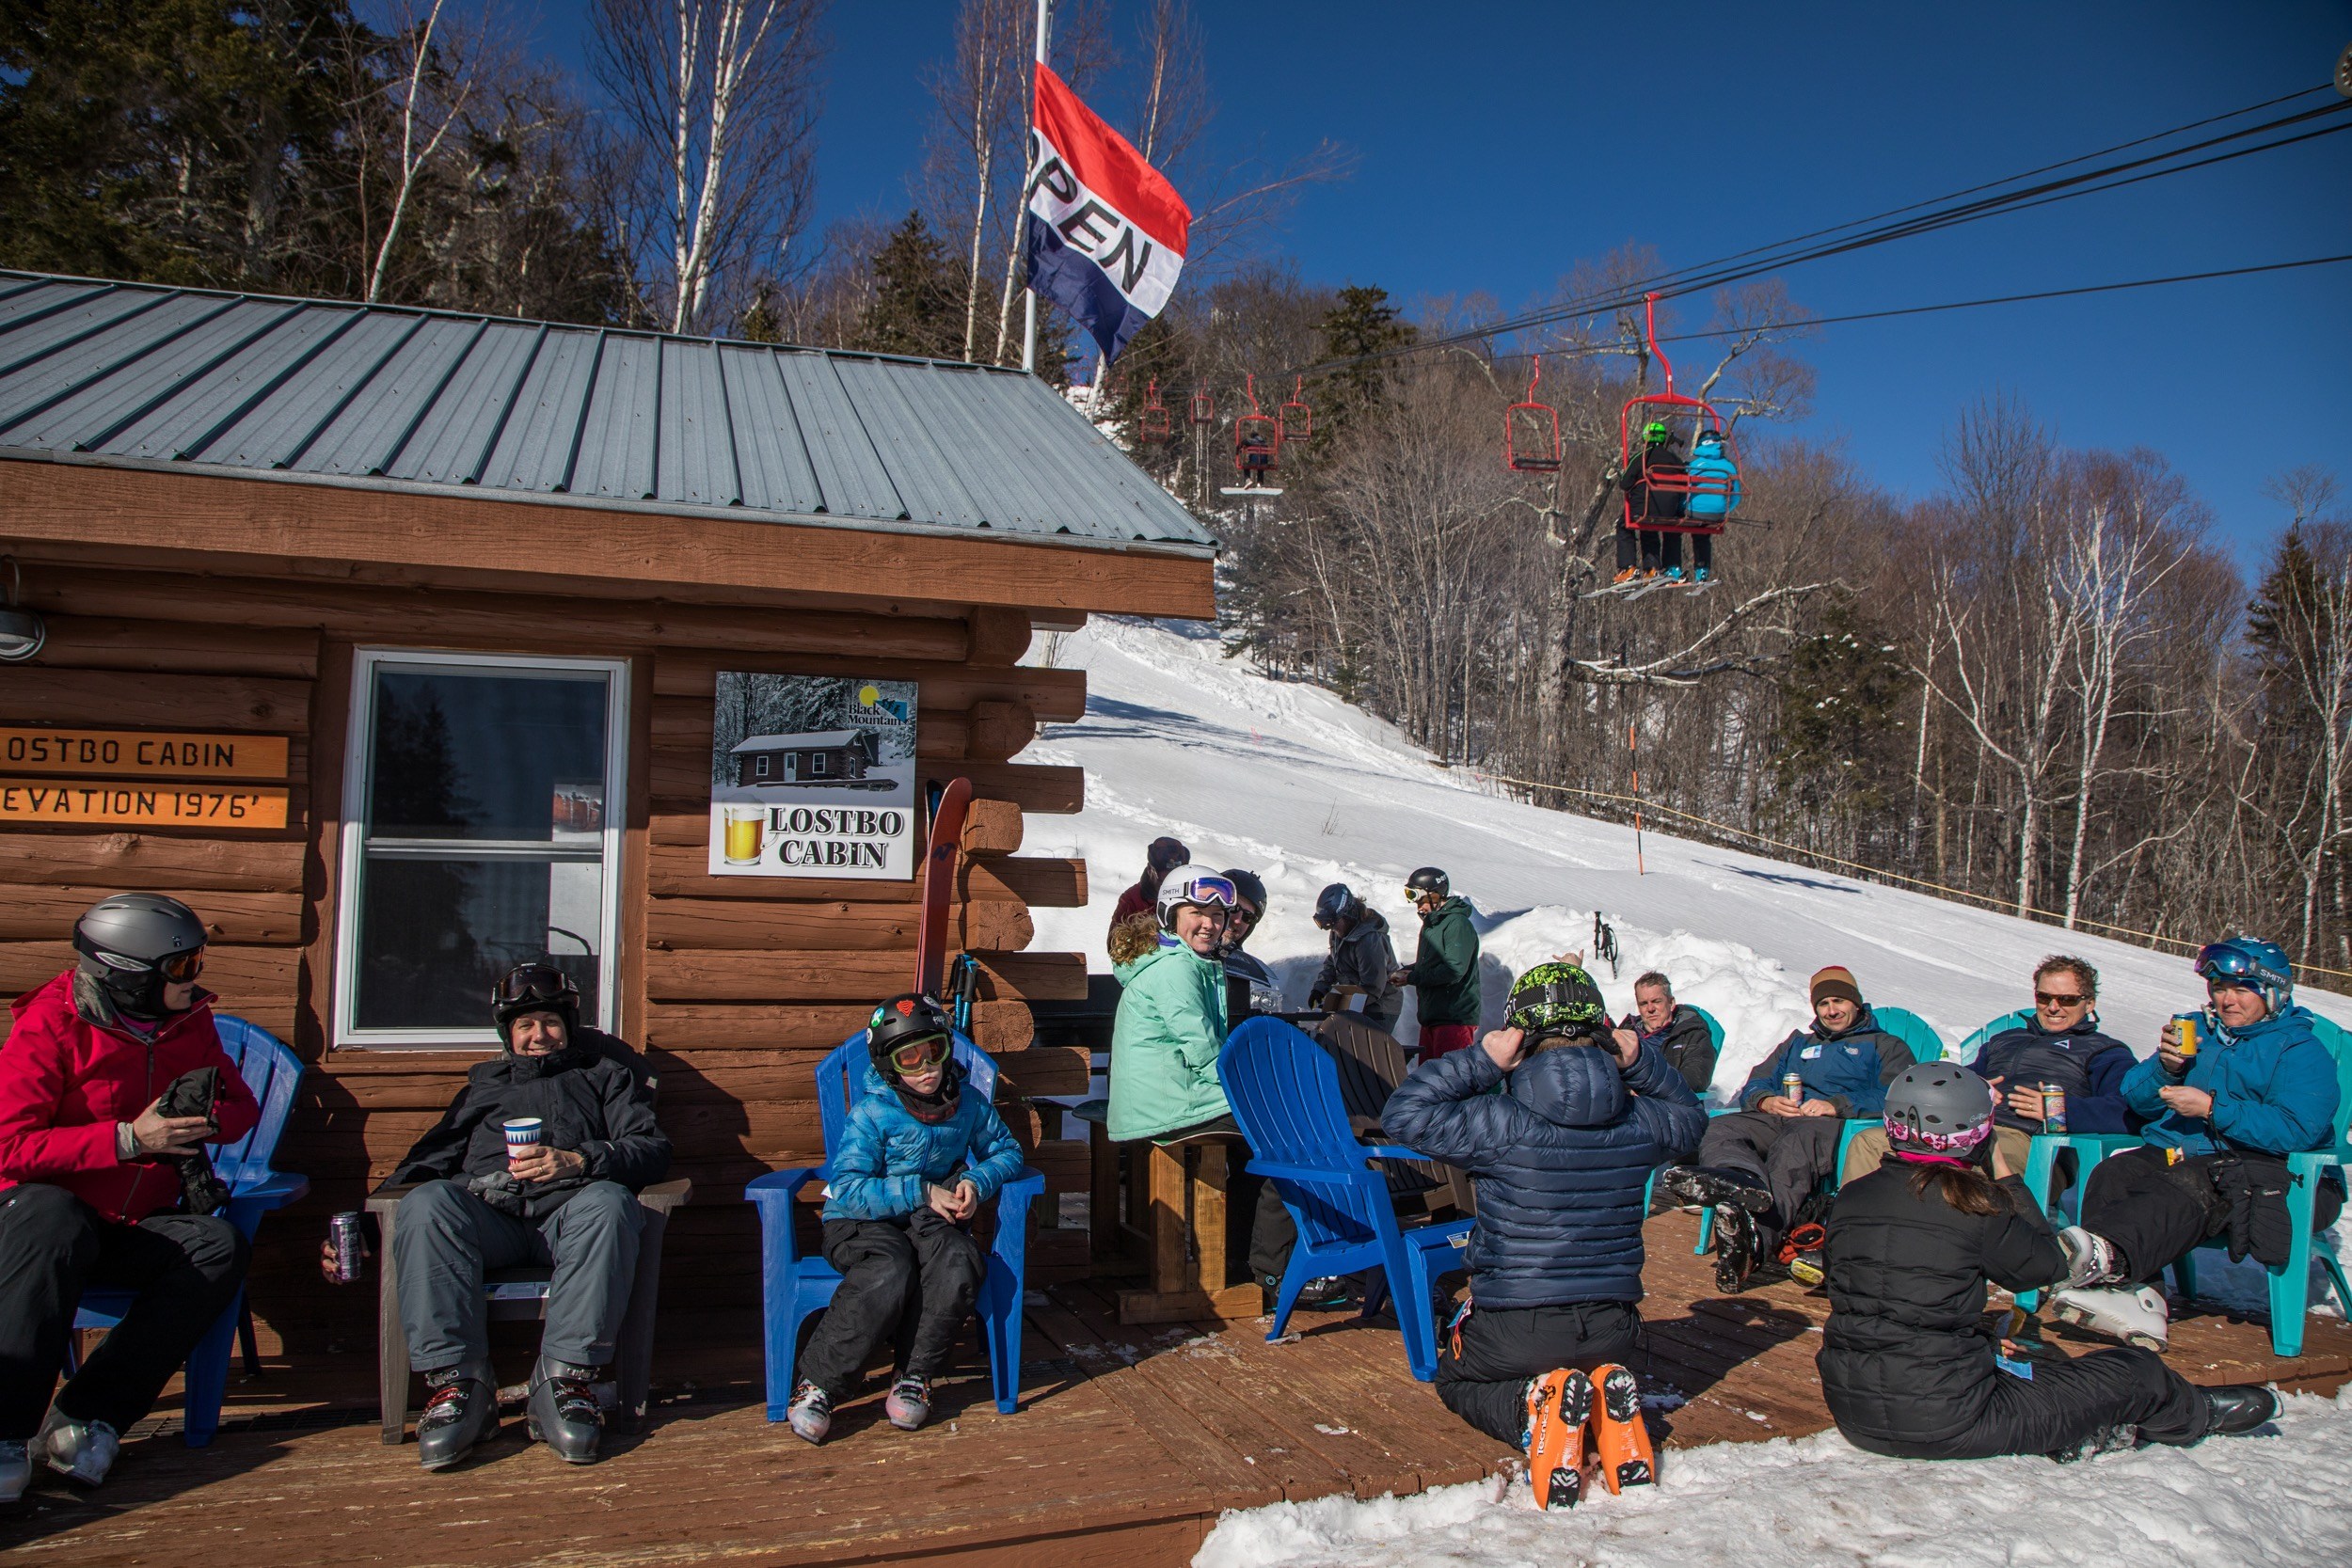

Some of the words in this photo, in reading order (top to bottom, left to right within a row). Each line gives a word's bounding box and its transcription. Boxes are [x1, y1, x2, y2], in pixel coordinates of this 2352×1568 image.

[848, 715, 901, 726] Mountain
[849, 702, 882, 716] Black
[136, 741, 235, 768] CABIN
[174, 792, 261, 818] 1976'
[768, 806, 904, 836] LOSTBO
[778, 839, 888, 868] CABIN
[2260, 968, 2286, 986] SMITH
